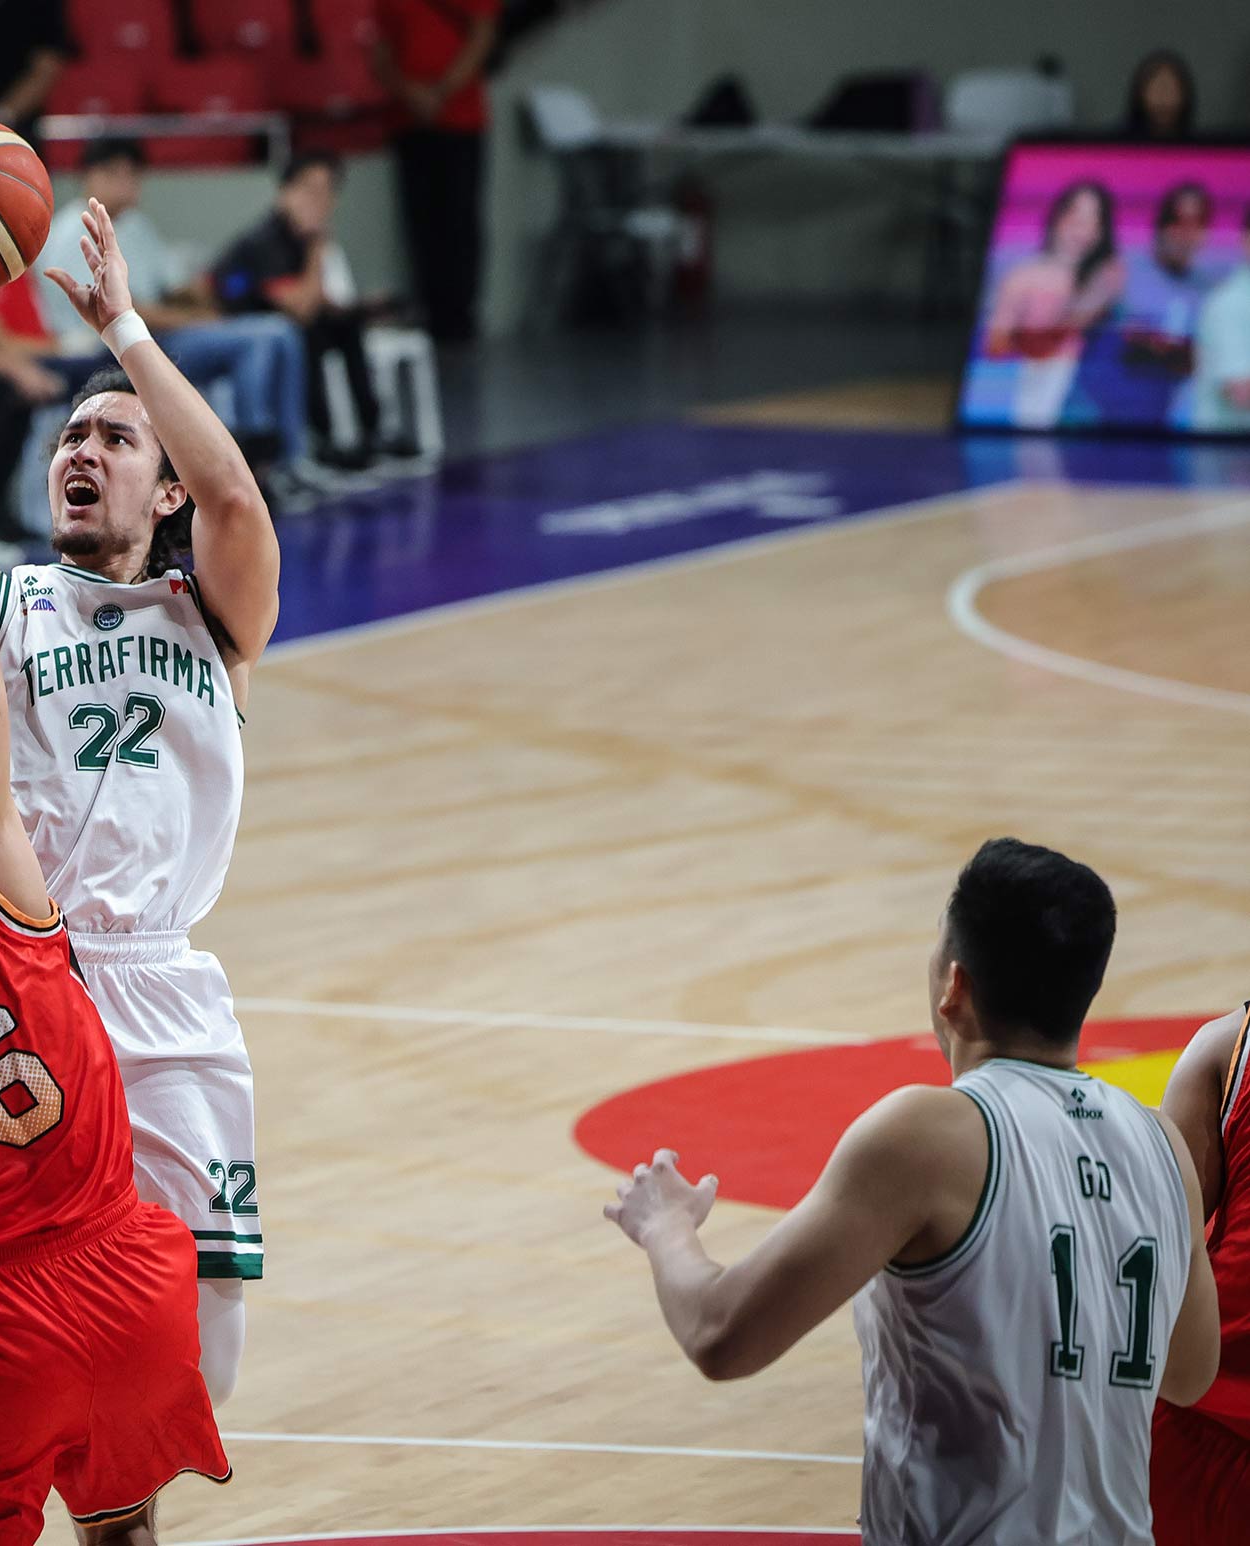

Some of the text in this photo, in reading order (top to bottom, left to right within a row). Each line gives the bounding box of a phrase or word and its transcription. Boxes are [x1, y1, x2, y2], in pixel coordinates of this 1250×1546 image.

[20, 635, 215, 707] TERRAFIRMA
[68, 692, 166, 772] 22
[206, 1159, 259, 1217] 22
[1050, 1224, 1158, 1389] 11
